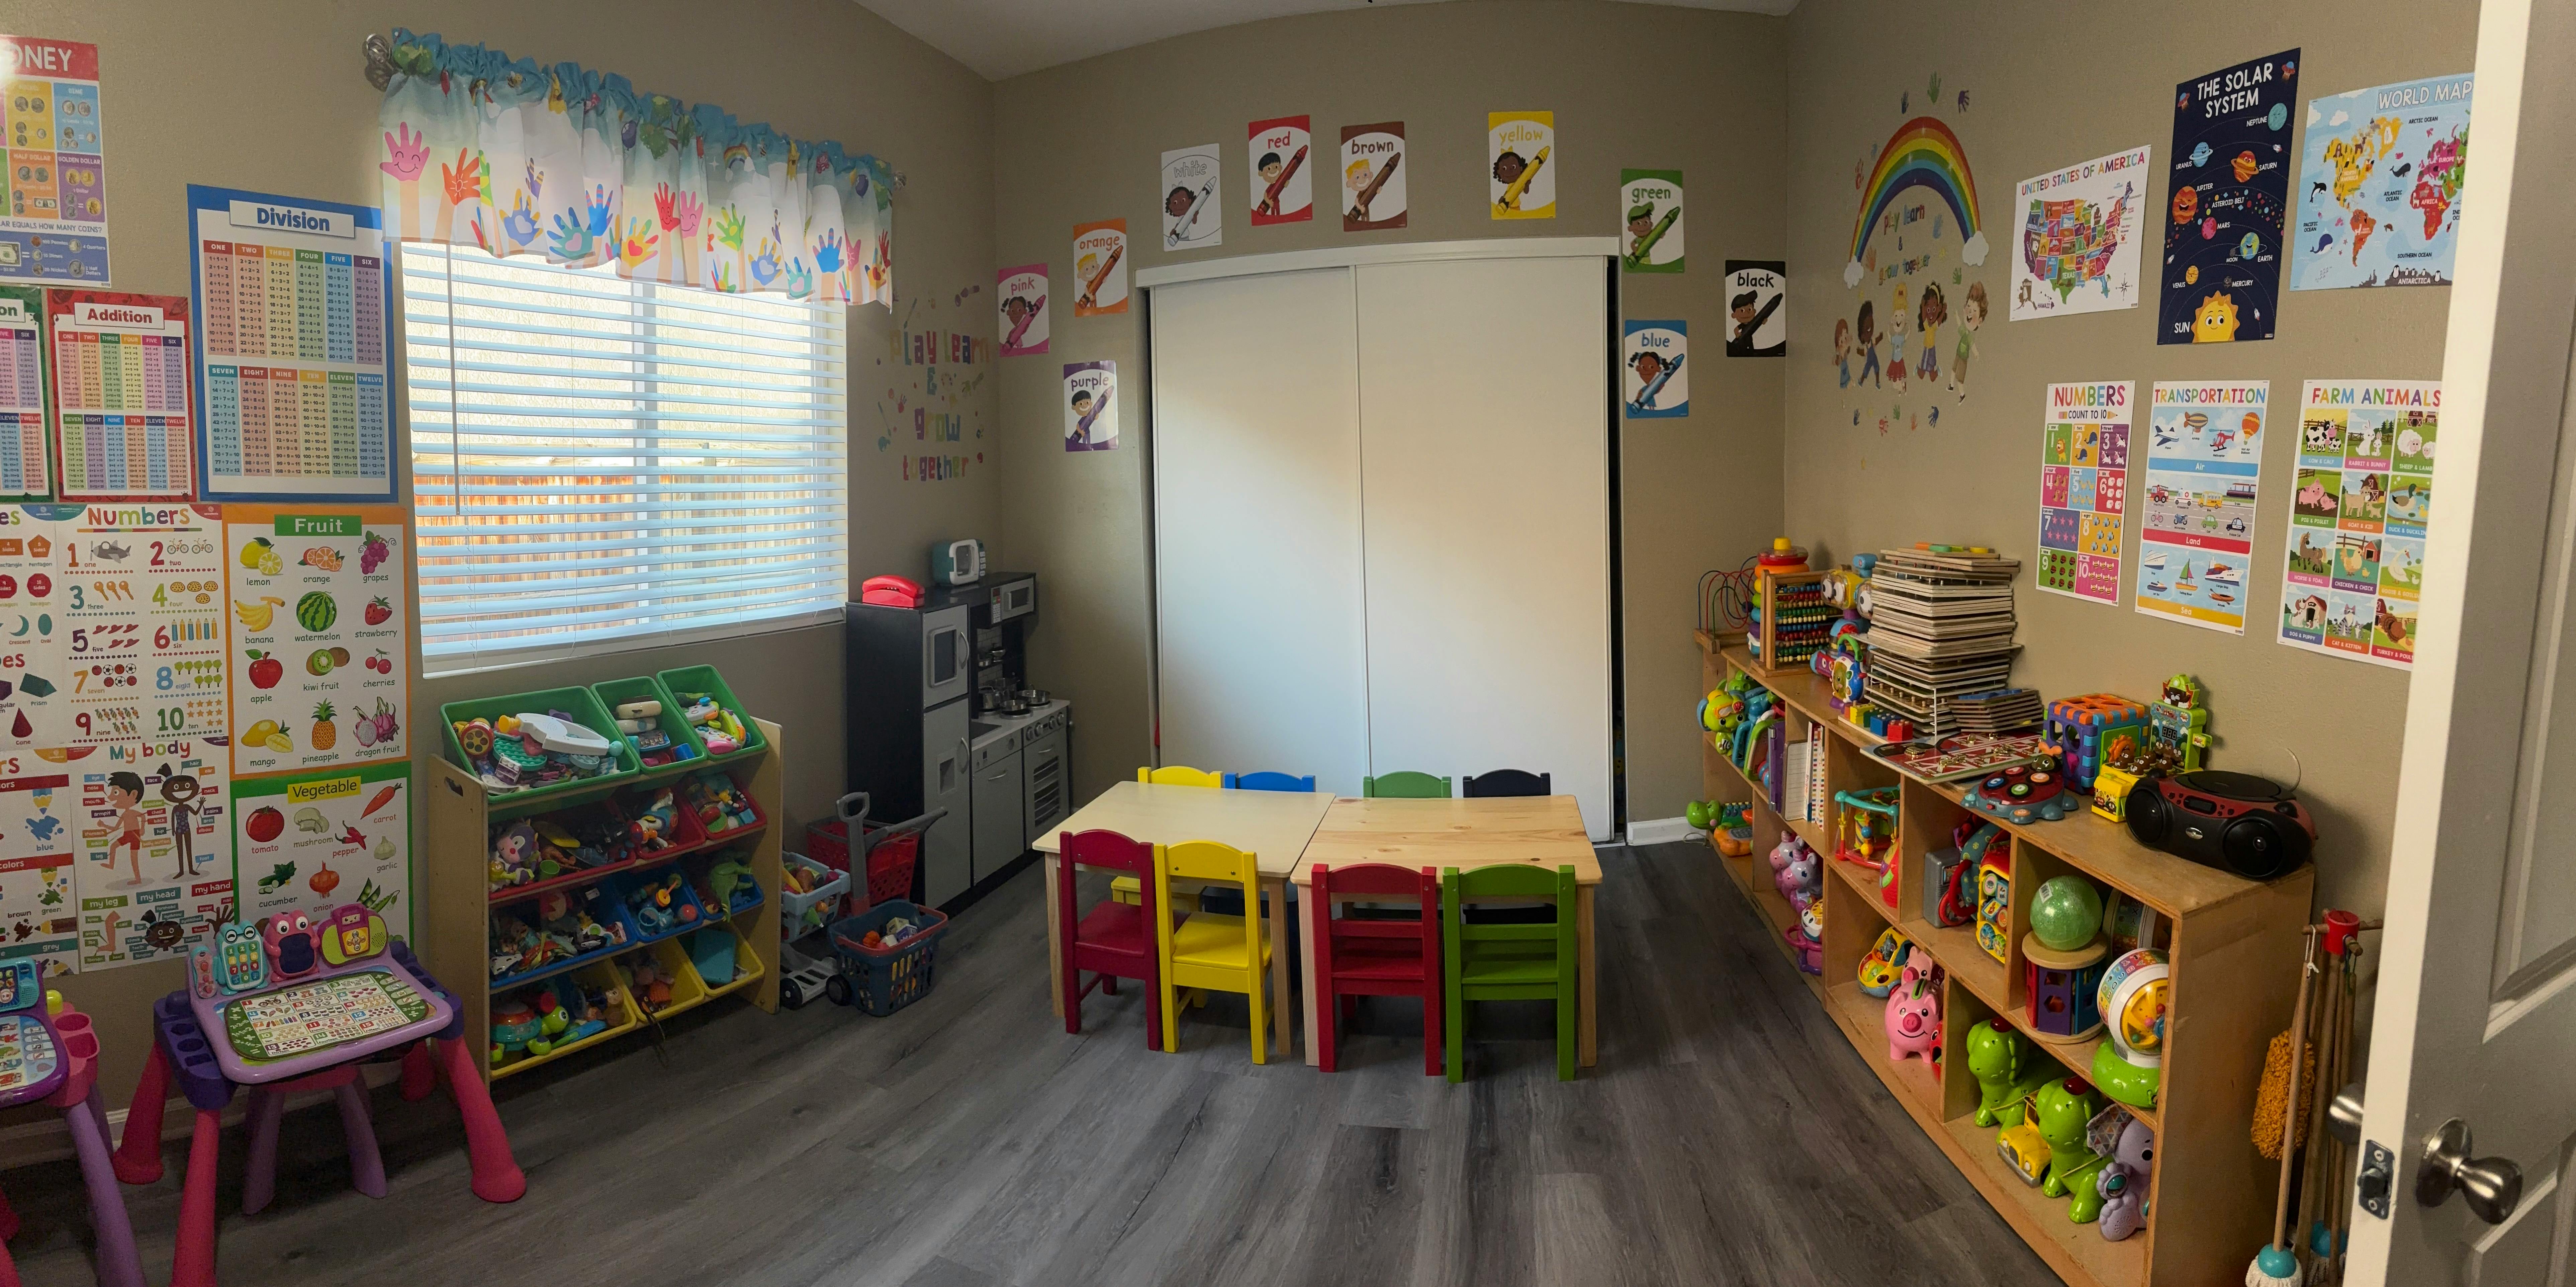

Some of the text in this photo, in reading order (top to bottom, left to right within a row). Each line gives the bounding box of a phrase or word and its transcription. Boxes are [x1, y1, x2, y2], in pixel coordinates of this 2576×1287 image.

[2197, 63, 2273, 101] THE SOLAR
[2379, 81, 2473, 110] WORLD MAP
[2205, 88, 2259, 118] SYSTEM
[2246, 116, 2267, 127] NEPTUNE
[1268, 132, 1291, 149] red
[1499, 127, 1543, 145] yellow
[1352, 139, 1394, 155] brown
[1174, 161, 1207, 178] white
[2176, 161, 2192, 170] URANUS
[2259, 162, 2277, 171] SATURN
[2022, 152, 2145, 196] UNITED STATES OF AMERICA
[1632, 184, 1671, 203] green
[2196, 183, 2213, 191] JUPITER
[2212, 198, 2233, 208] ASTEROID
[257, 207, 330, 232] Division
[1079, 235, 1120, 251] orange
[2258, 254, 2273, 263] EARTH
[1011, 277, 1035, 293] pink
[1737, 272, 1774, 288] black
[2232, 279, 2253, 288] MERCURY
[87, 308, 152, 323] Addition
[2174, 322, 2190, 333] SUN
[1641, 333, 1670, 348] blue
[1071, 373, 1109, 391] purple
[2054, 385, 2125, 407] NUMBERS
[2155, 388, 2266, 404] TRANSPORTATION
[2312, 388, 2441, 406] FARM ANIMALS
[2068, 410, 2107, 419] COUNT TO 10
[2195, 463, 2205, 471] Air
[88, 507, 190, 526] Numbers
[295, 519, 343, 533] Fruit
[2186, 537, 2200, 546] Land
[67, 543, 79, 567] 1
[150, 541, 165, 566] 2
[303, 575, 331, 584] orange
[363, 574, 388, 583] grapes
[2334, 581, 2353, 589] CHICKEN
[69, 585, 85, 609] 3
[152, 583, 168, 607] 4
[2181, 607, 2192, 616] Sea
[154, 625, 170, 649] 6
[295, 633, 340, 641] watermelon
[355, 629, 397, 638] strawberry
[72, 629, 88, 652] 5
[74, 670, 88, 694] 7
[156, 667, 173, 690] 8
[363, 679, 395, 687] cherries
[303, 682, 339, 691] kiwi fruit
[251, 694, 272, 703] apple
[76, 712, 91, 736] 9
[157, 707, 184, 732] 10
[110, 741, 191, 764] My body
[355, 745, 400, 757] dragon fruit
[250, 759, 276, 767] mango
[302, 753, 339, 763] pineapple
[292, 780, 357, 799] Vegetable
[374, 814, 396, 823] carrot
[294, 837, 333, 848] mushroom
[252, 845, 279, 854] tomato
[333, 848, 358, 858] pepper
[377, 862, 397, 873] garlic
[195, 882, 231, 894] my hand
[140, 890, 176, 902] my head
[259, 896, 297, 908] cucumber
[89, 898, 118, 908] my leg
[313, 904, 333, 912] onion
